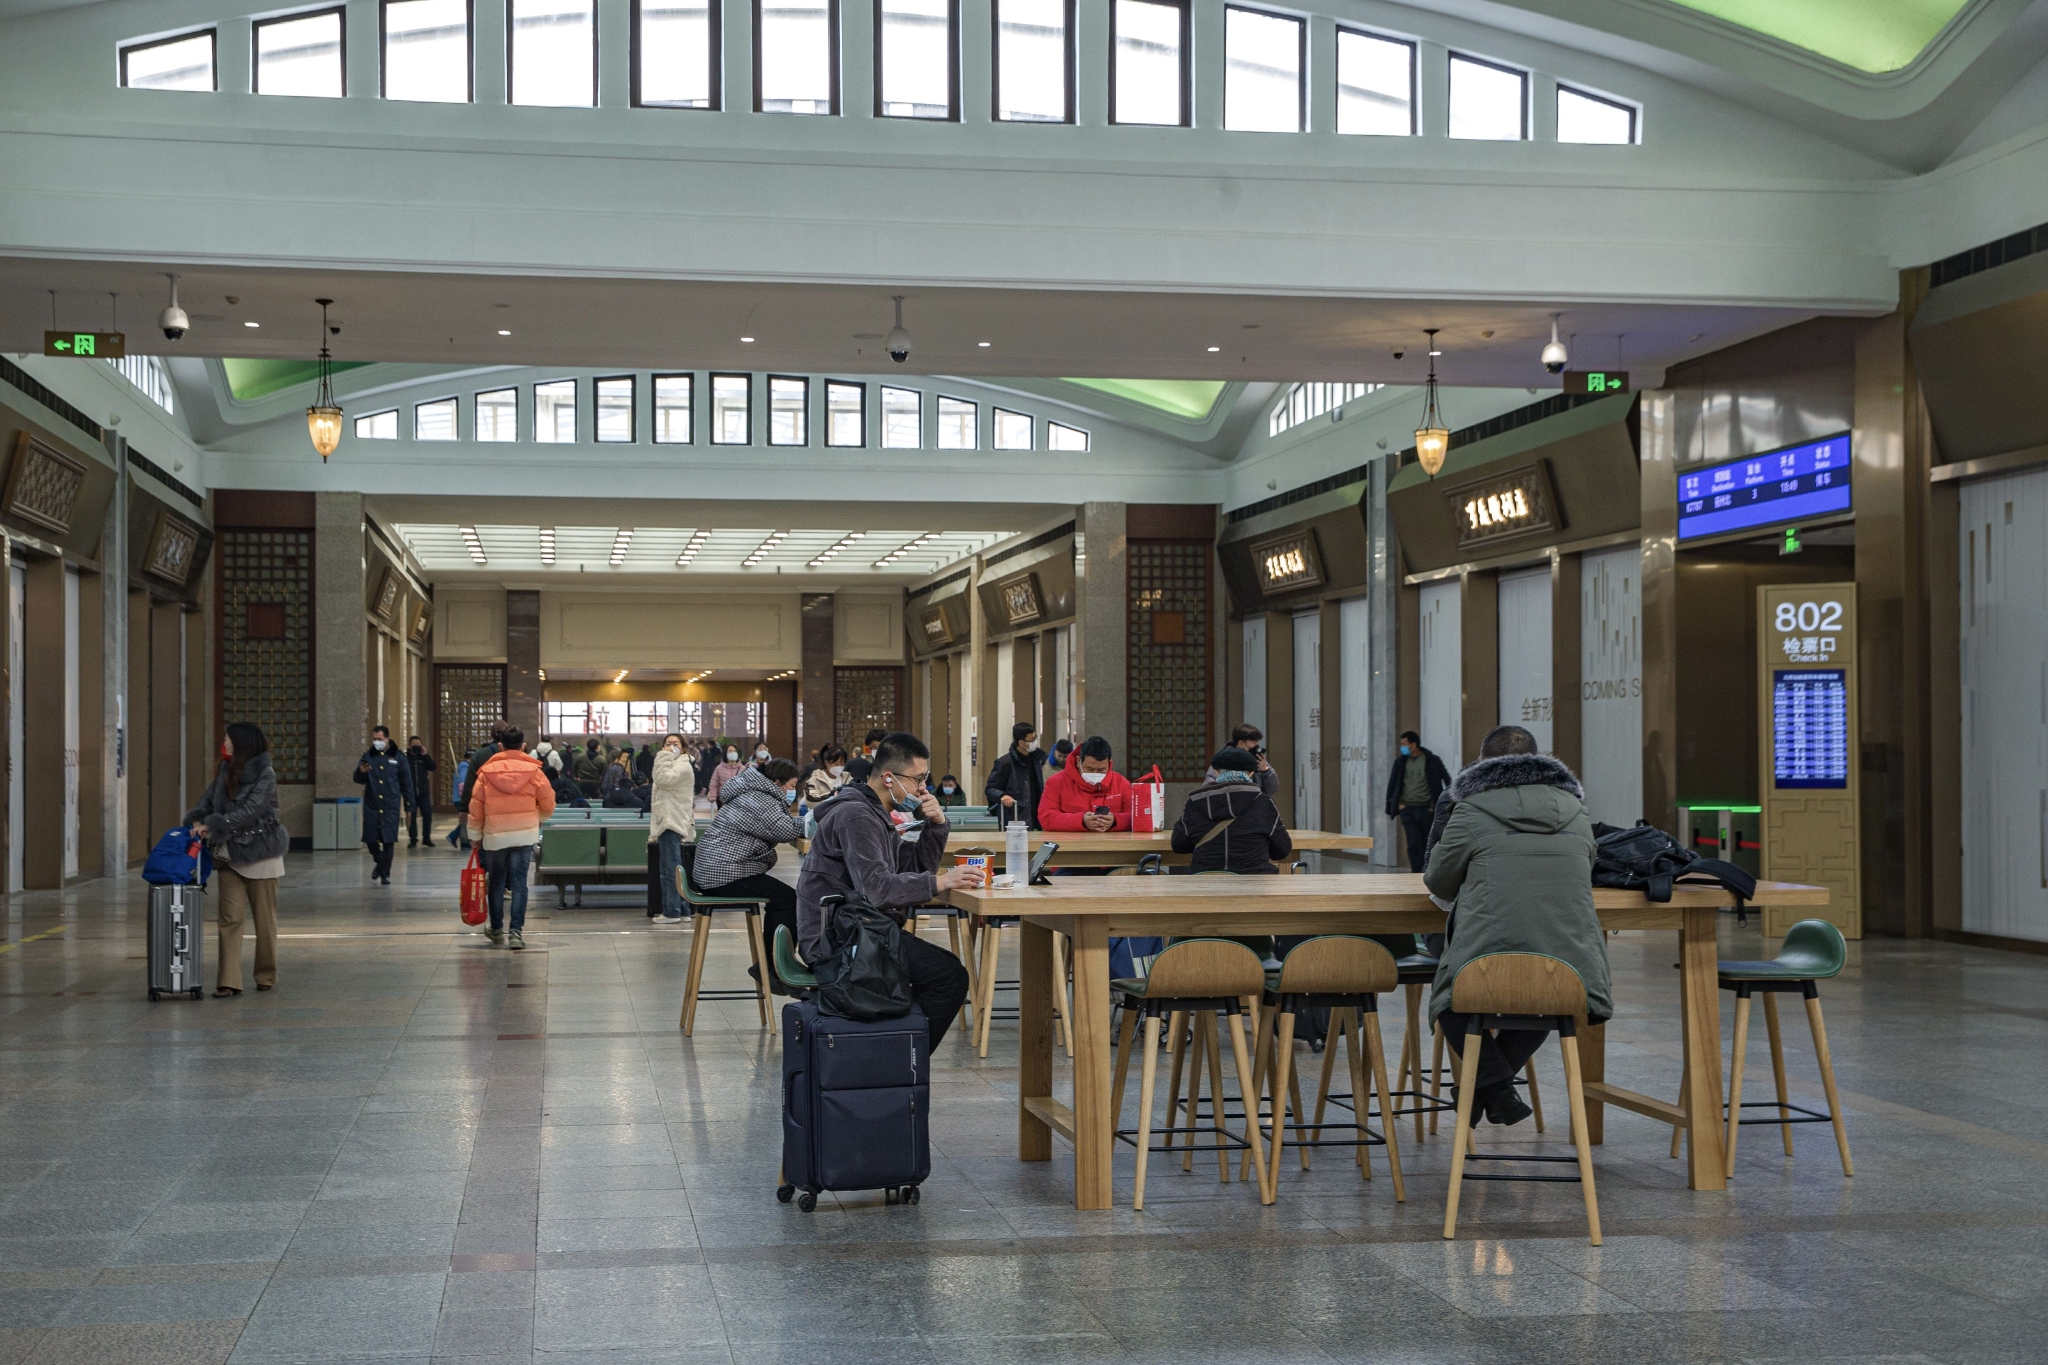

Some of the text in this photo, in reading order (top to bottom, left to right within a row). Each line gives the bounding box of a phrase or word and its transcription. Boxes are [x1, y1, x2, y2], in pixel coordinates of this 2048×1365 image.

[1775, 601, 1843, 632] 802
[1783, 637, 1836, 654] 检票口
[1789, 653, 1818, 662] Check
[1583, 677, 1642, 700] COMING S
[1342, 746, 1368, 762] COMING
